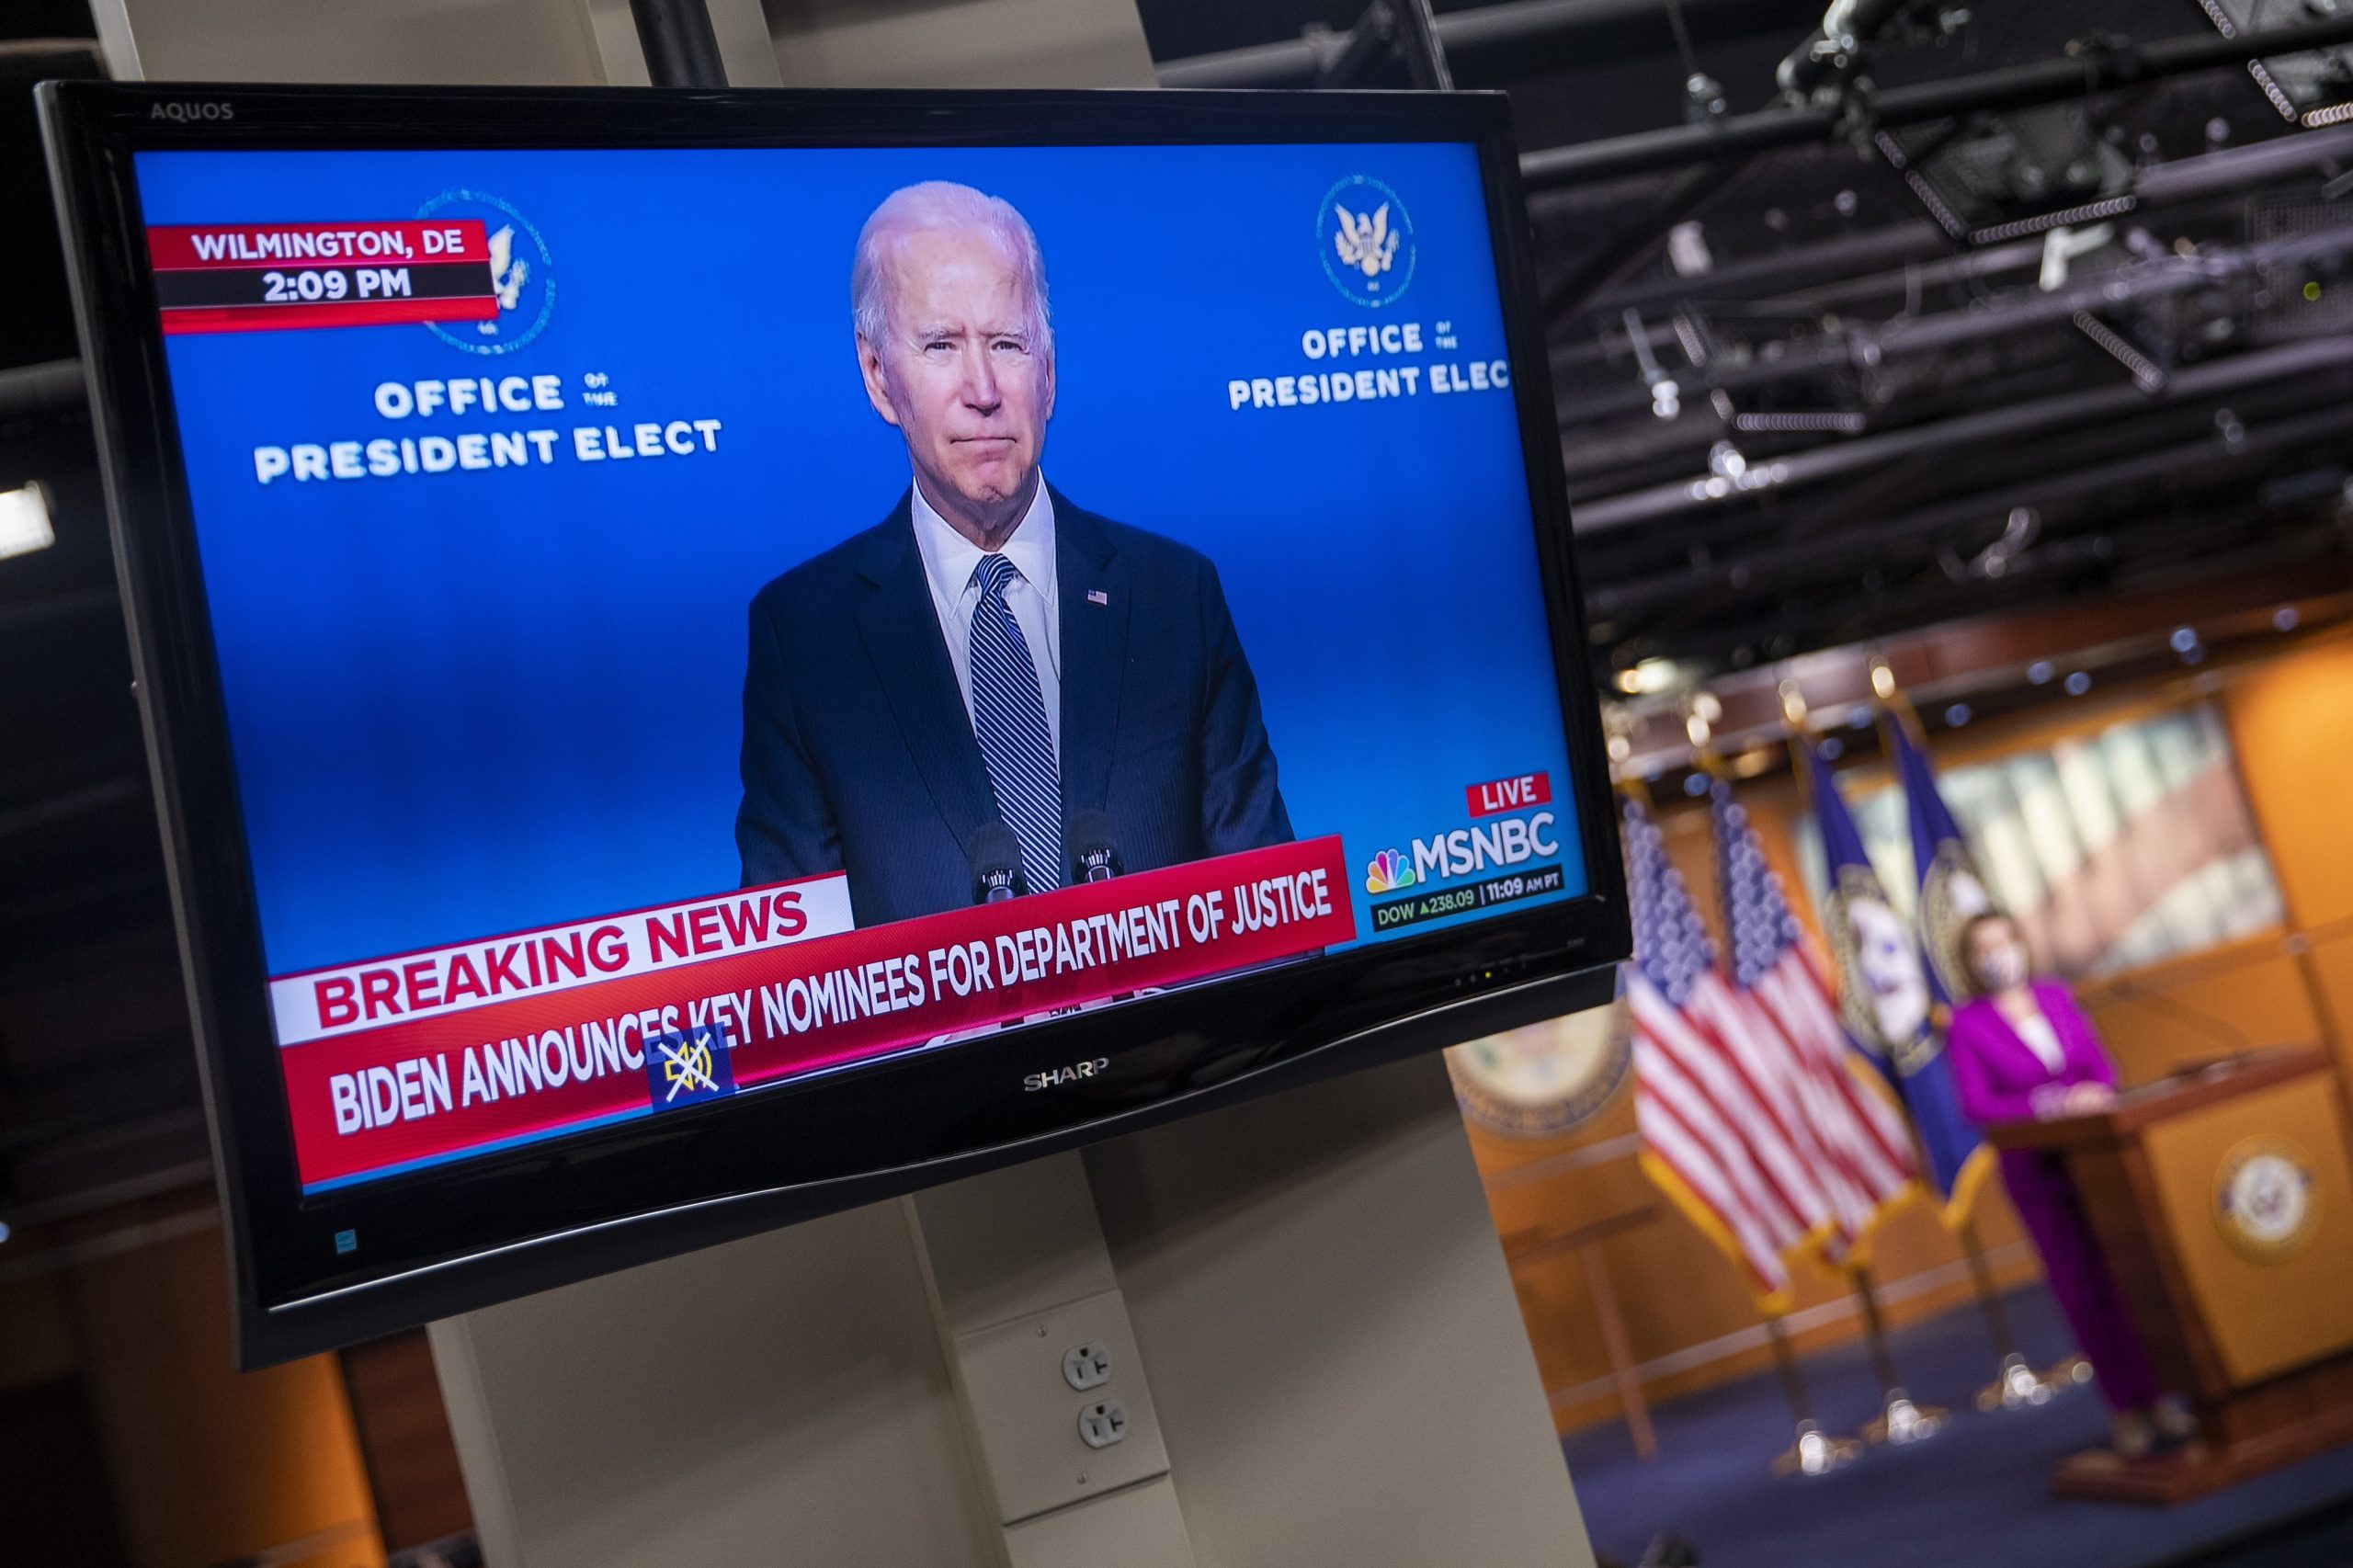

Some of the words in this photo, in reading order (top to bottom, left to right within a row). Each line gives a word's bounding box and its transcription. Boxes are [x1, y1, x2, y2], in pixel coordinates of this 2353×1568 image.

[151, 102, 234, 122] AQUOS
[191, 231, 414, 260] WILMINGTON,
[422, 229, 465, 256] DE
[263, 270, 348, 301] 2:09
[356, 267, 413, 299] PM
[1302, 323, 1424, 359] OFFICE
[374, 374, 565, 420] OFFICE
[1228, 366, 1420, 411] PRESIDENT
[1428, 358, 1510, 394] ELEC
[254, 428, 559, 485] PRESIDENT
[573, 418, 722, 461] ELECT
[1481, 775, 1538, 811] LIVE
[1411, 811, 1560, 884] MSNBC
[1486, 877, 1525, 902] 11:09
[1526, 879, 1545, 892] AM
[1544, 872, 1560, 889] PT
[1378, 902, 1415, 926] DOW
[313, 925, 630, 1029] BREAKING
[645, 892, 807, 963] NEWS
[329, 1052, 454, 1136] BIDEN
[461, 1005, 684, 1108] ANNOUNCES
[688, 989, 753, 1051] KEY
[760, 953, 925, 1040] NOMINEES
[927, 942, 994, 1001] FOR
[995, 898, 1180, 986] DEPARTMENT
[1187, 891, 1224, 944] OF
[1230, 869, 1333, 937] JUSTICE
[1023, 1057, 1109, 1093] SHARP
